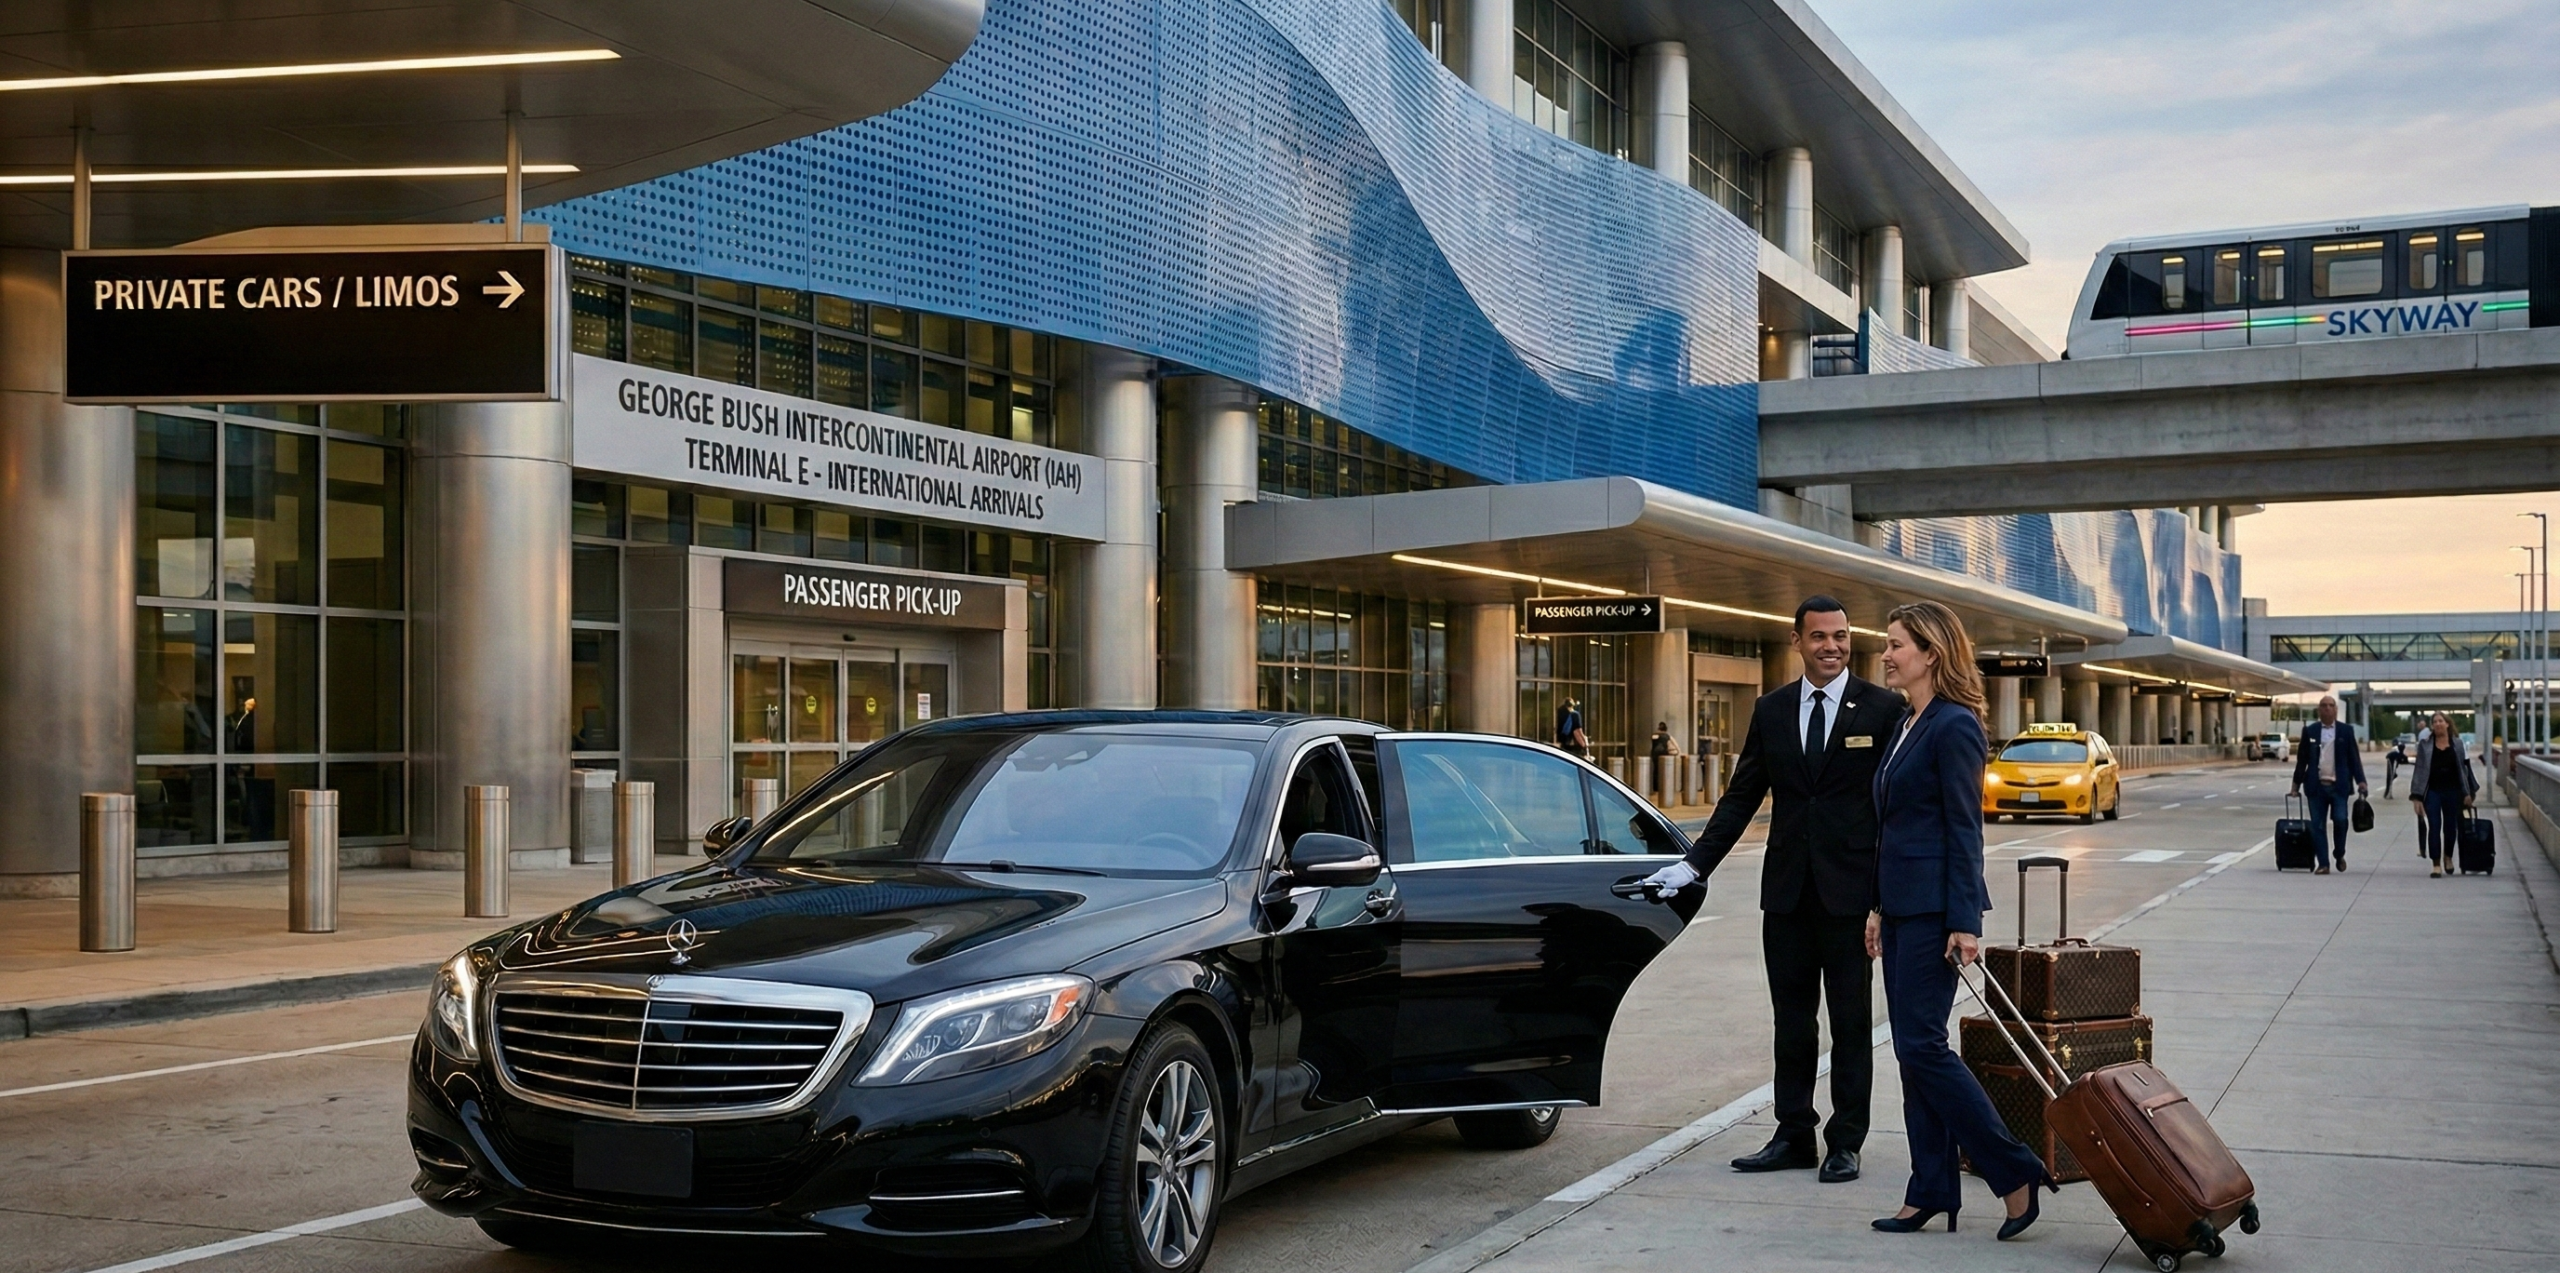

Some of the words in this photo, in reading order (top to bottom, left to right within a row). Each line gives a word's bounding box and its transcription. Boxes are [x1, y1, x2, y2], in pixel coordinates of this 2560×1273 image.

[94, 278, 226, 310] PRIVATE
[236, 276, 322, 309] CARS
[332, 276, 345, 309] /
[356, 274, 459, 308] LIMOS
[2327, 301, 2479, 337] SKYWAY
[618, 377, 715, 426] GEORGE
[722, 396, 779, 437] BUSH
[786, 408, 969, 470] INTERCONTINENTAL
[971, 445, 1042, 483] AIRPORT
[1044, 456, 1082, 495] (IAH)
[684, 437, 793, 484] TERMINAL
[798, 456, 810, 486] E
[828, 461, 967, 509] INTERNATIONAL
[969, 485, 1044, 520] ARRIVALS
[784, 573, 891, 611] PASSENGER
[895, 584, 962, 616] PICK-UP
[1535, 605, 1594, 618] PASSENGER
[1595, 604, 1636, 617] PICK-UP
